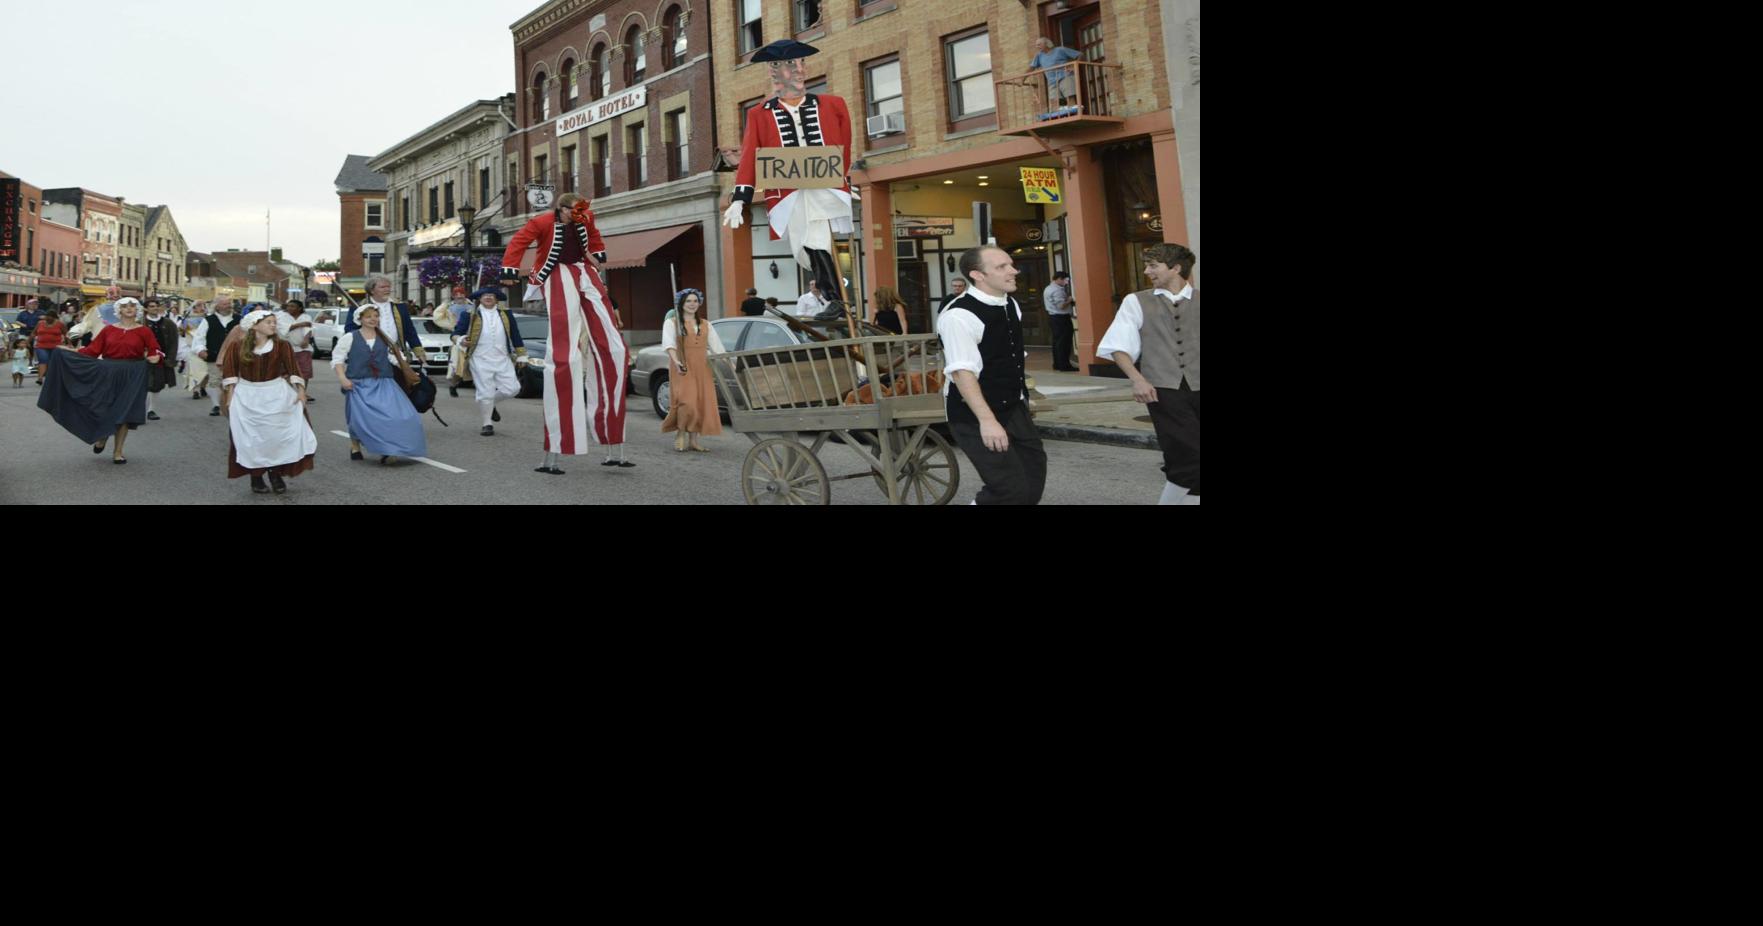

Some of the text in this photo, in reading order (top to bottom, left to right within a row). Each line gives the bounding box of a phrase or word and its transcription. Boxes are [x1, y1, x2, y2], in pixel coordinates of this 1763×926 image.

[563, 93, 635, 131] ROYAL HOTEL
[757, 155, 842, 179] TRAITOR
[1023, 170, 1056, 180] 24 HOUR
[1026, 179, 1057, 188] ATM
